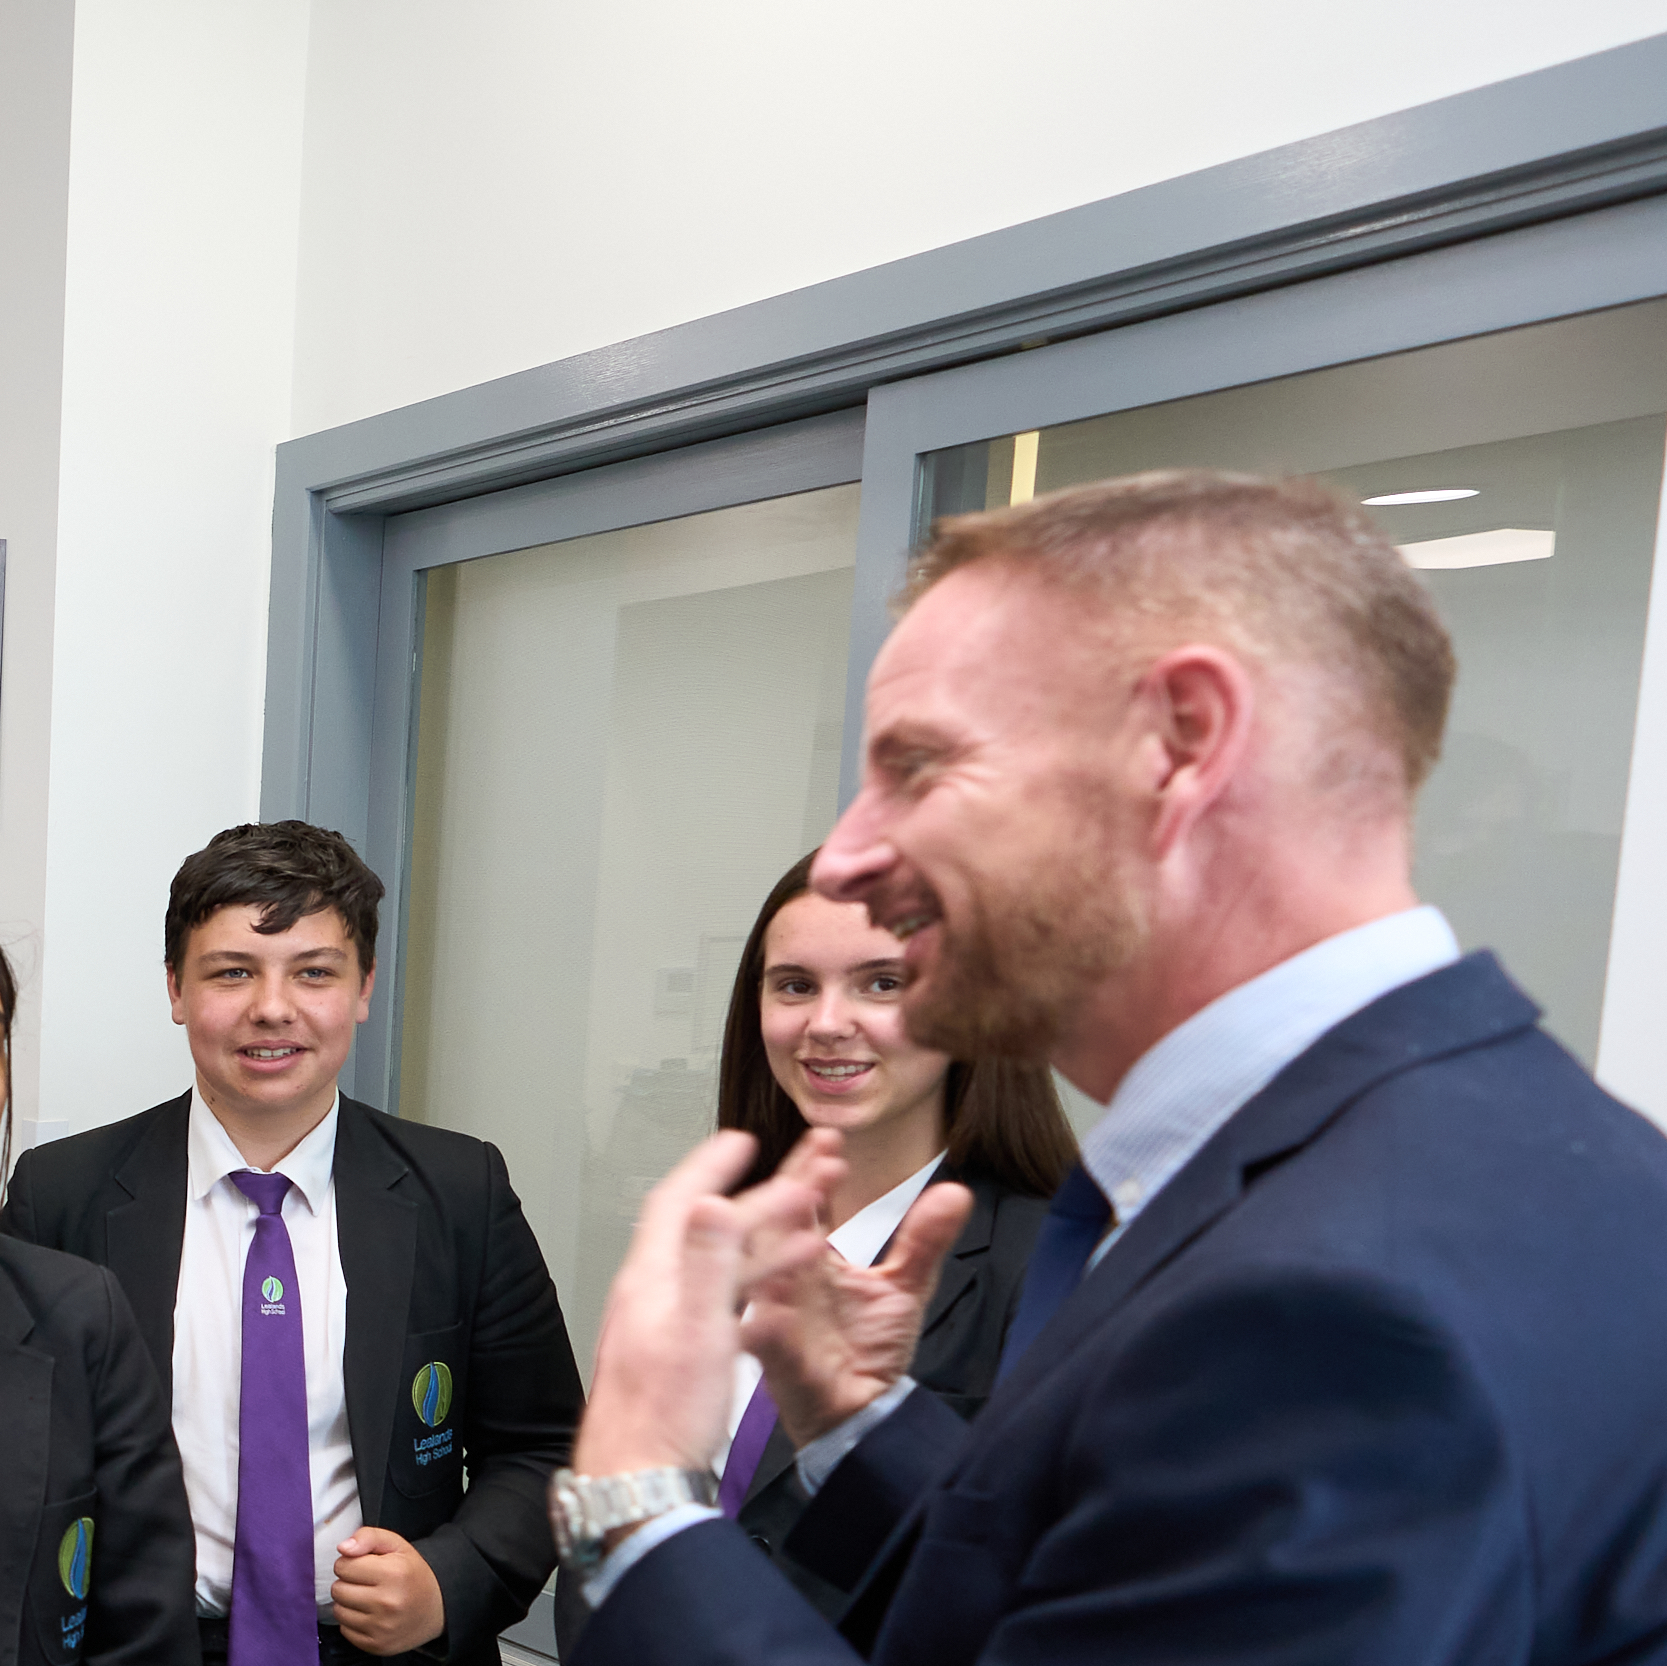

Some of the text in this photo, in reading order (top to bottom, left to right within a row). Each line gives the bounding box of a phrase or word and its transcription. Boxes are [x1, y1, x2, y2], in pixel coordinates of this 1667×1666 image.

[413, 1428, 453, 1452] Lealands
[415, 1442, 453, 1466] High School
